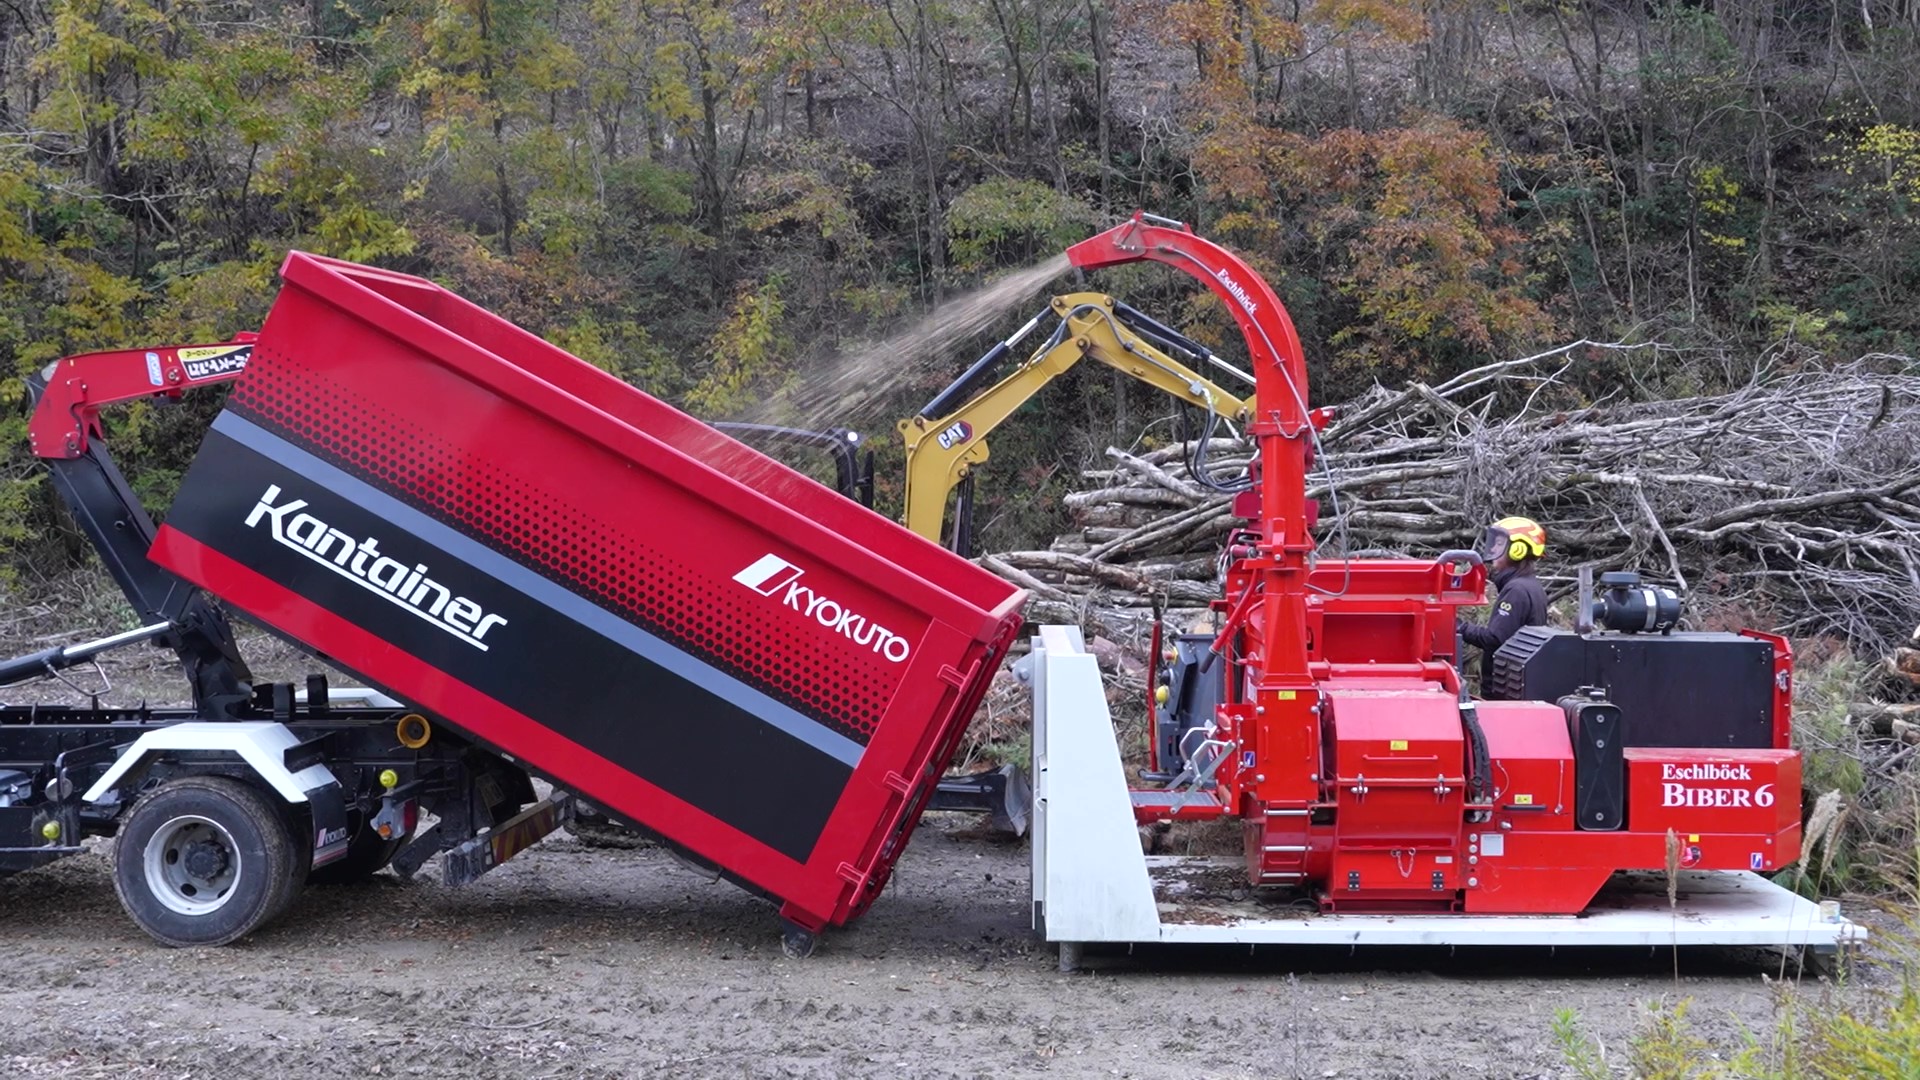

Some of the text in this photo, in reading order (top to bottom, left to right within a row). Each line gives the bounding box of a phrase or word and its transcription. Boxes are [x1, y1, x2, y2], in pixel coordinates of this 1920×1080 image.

[937, 422, 965, 449] CAT
[244, 484, 508, 649] Kantainer
[783, 581, 909, 662] KYOKUTO
[1662, 764, 1751, 780] Eschlböck
[1662, 783, 1774, 807] BIBER 6
